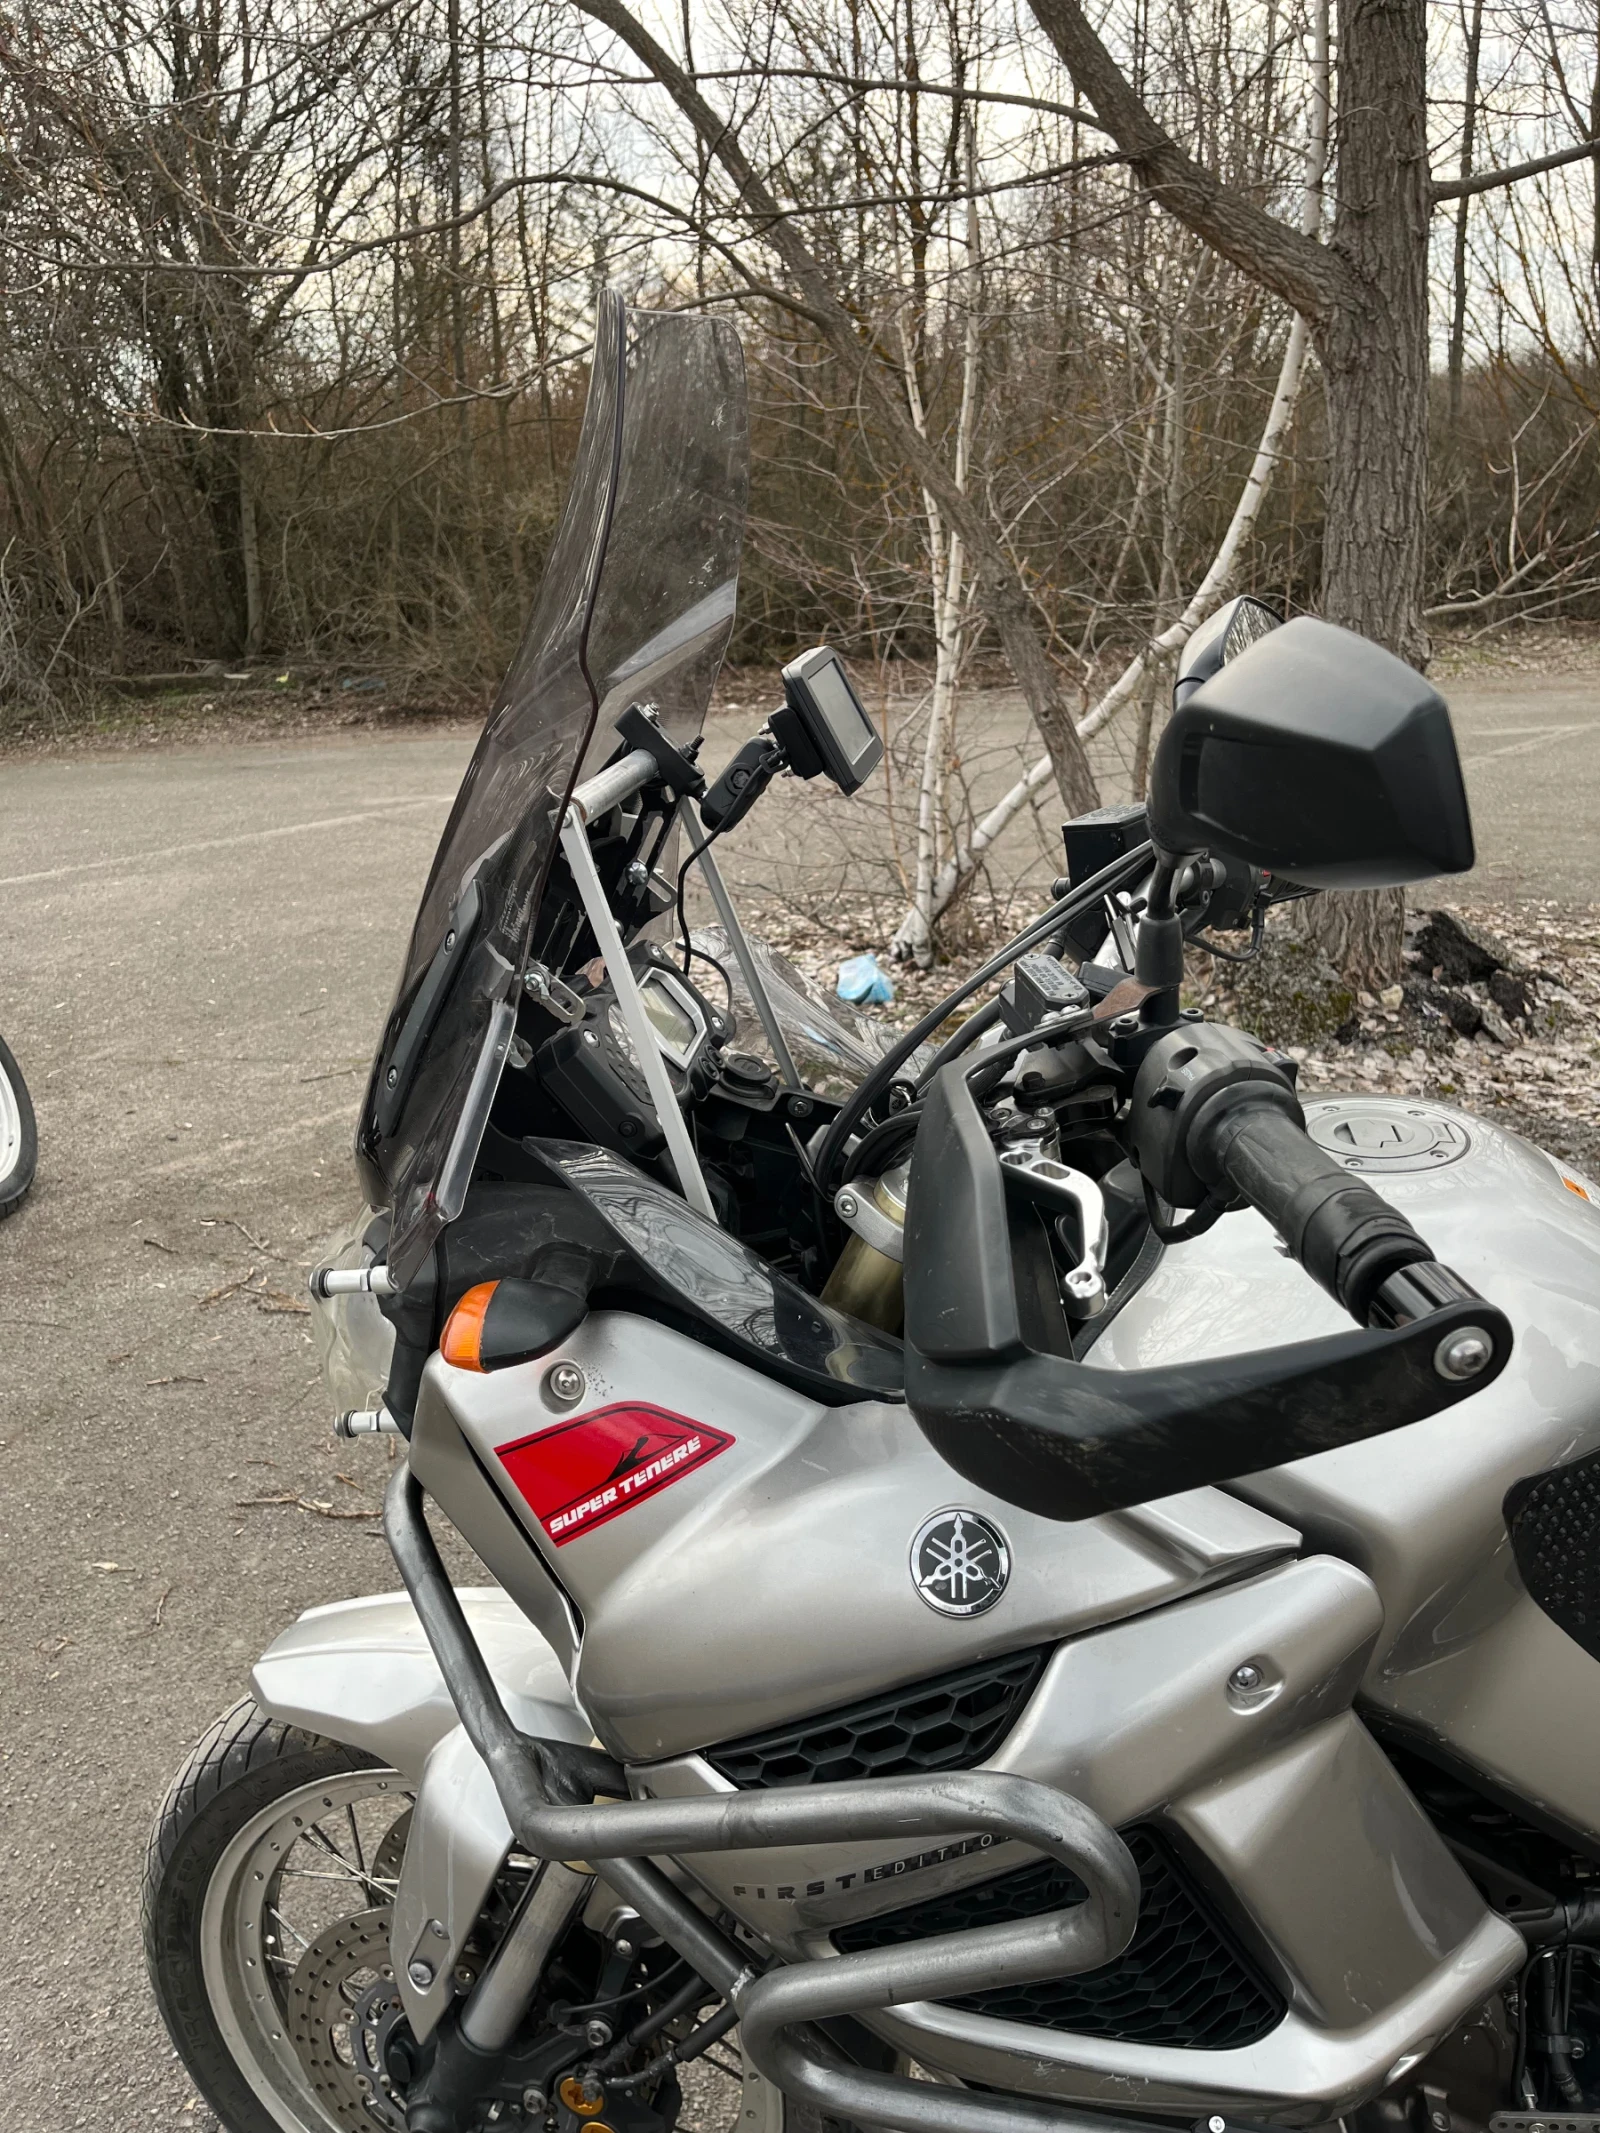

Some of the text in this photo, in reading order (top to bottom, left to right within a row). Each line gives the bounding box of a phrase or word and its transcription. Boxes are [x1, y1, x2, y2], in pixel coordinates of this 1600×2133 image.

[549, 1435, 701, 1534] SUPER TENERE
[733, 1833, 1008, 1899] FIRST EDITIO
